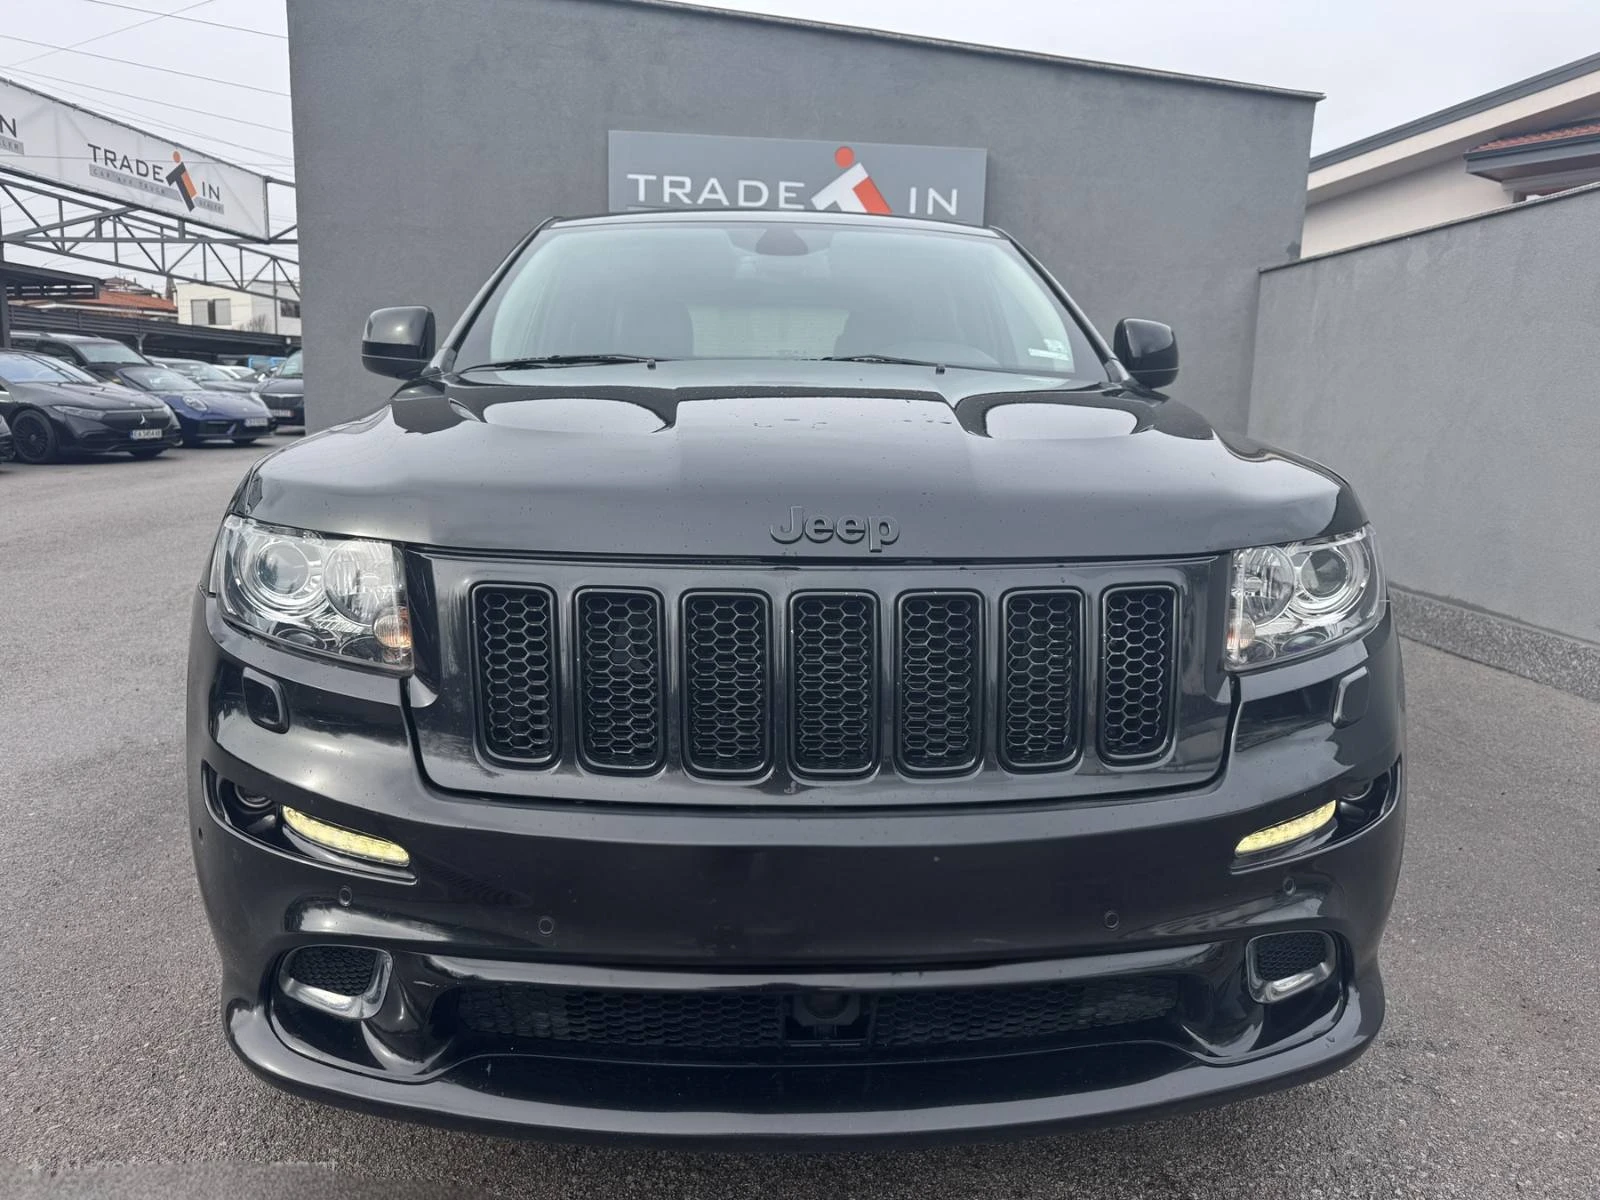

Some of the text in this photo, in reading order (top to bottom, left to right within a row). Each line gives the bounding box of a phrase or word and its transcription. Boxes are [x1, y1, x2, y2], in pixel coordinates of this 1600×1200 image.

[87, 143, 220, 201] TRADE IN
[627, 173, 958, 216] TRADE IN
[769, 505, 900, 553] Jeep
